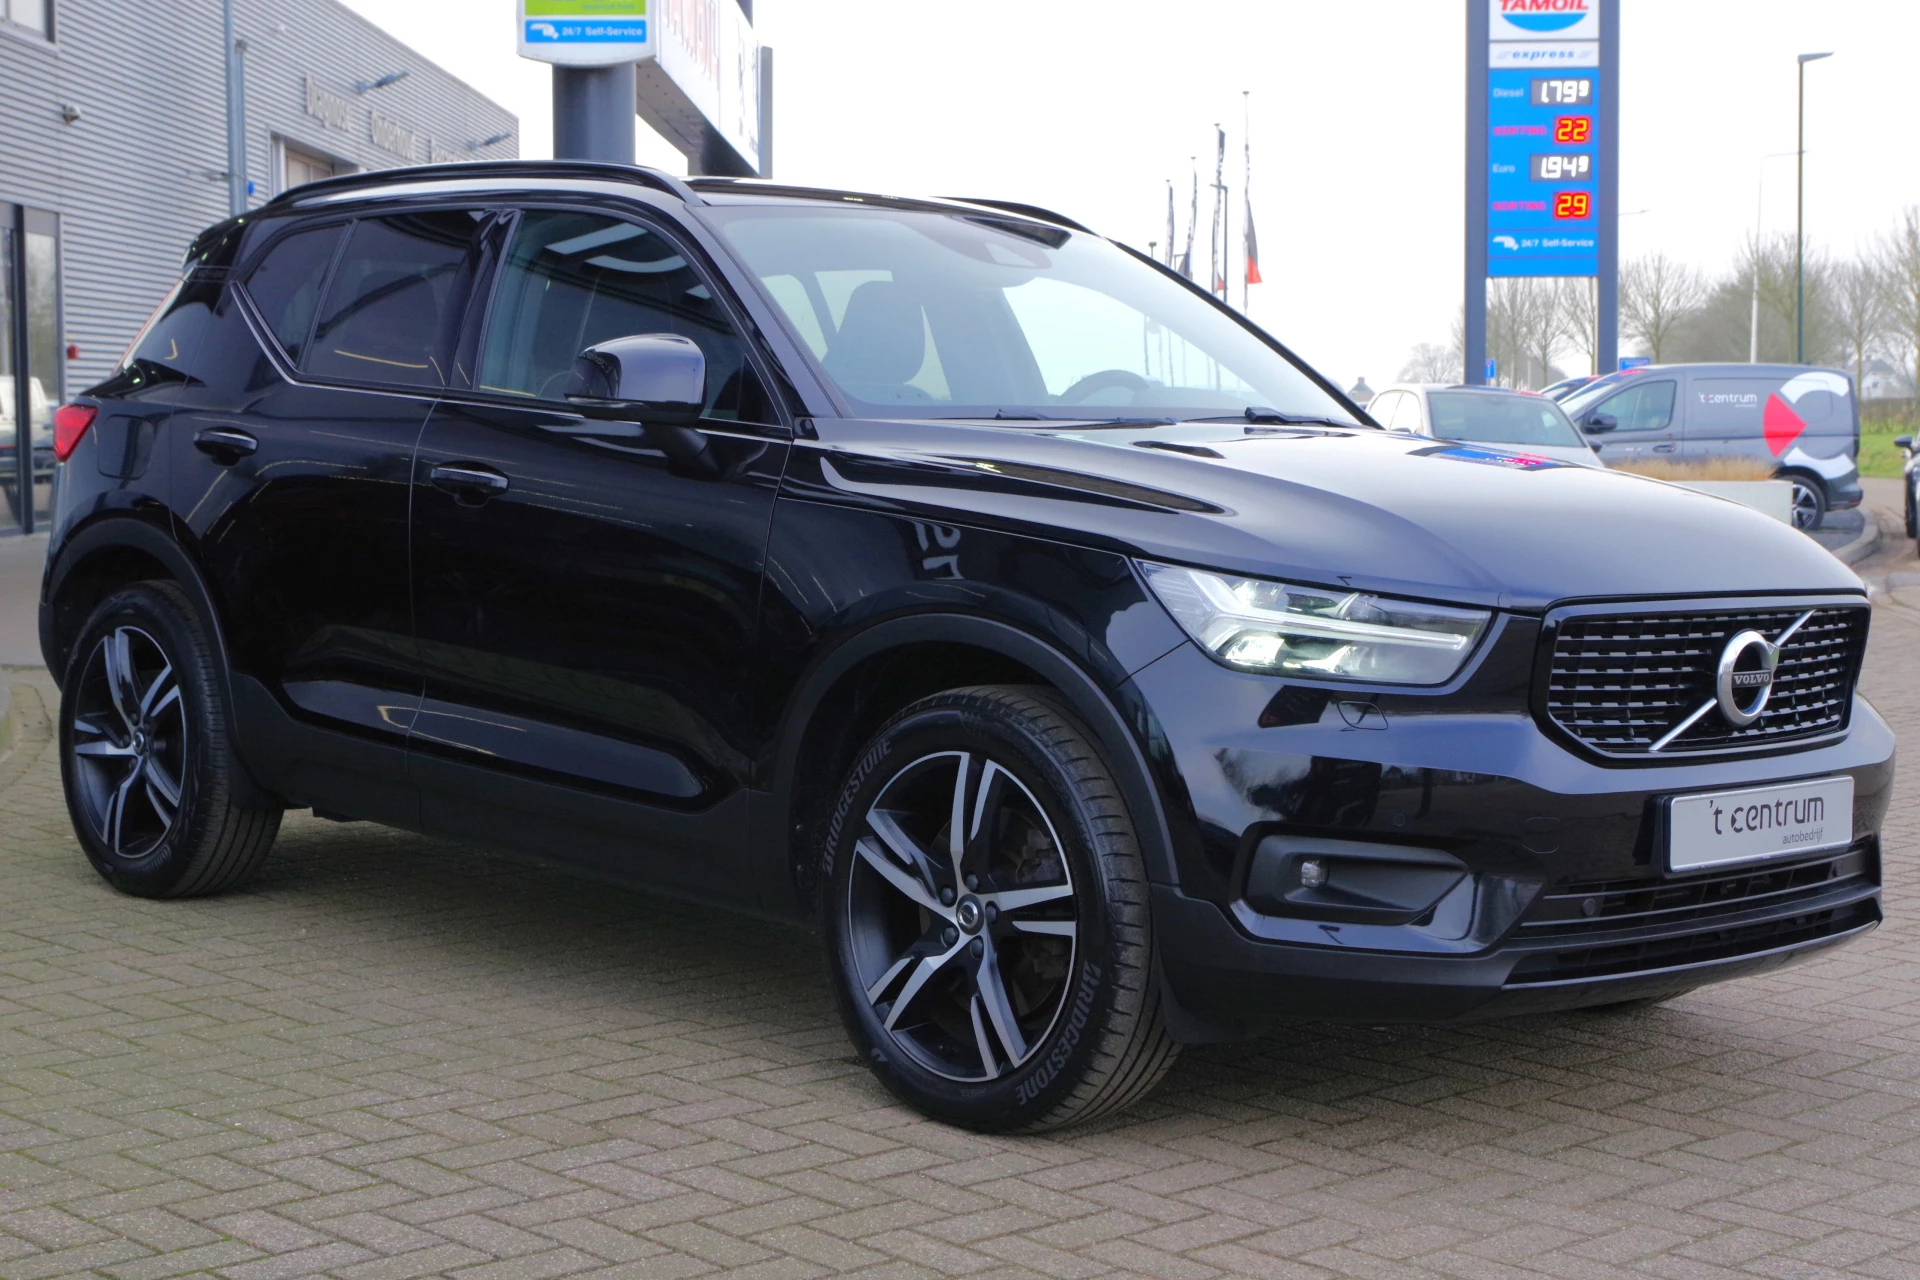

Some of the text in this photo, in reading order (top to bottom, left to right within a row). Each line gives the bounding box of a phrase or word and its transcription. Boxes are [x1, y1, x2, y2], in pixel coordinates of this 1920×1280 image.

[1499, 0, 1589, 11] TAMOIL
[562, 26, 643, 37] 24/7 Self-Service
[1512, 51, 1575, 61] express
[1492, 87, 1524, 98] Diesel
[1557, 119, 1589, 142] 22
[1492, 163, 1516, 174] Euro
[1557, 194, 1588, 217] 29
[1521, 237, 1594, 248] 24/7 Self-Service
[1707, 393, 1758, 404] centrum
[1733, 673, 1770, 686] VOLVO
[822, 738, 893, 877] BRIDGESTONE
[1709, 796, 1825, 835] 't centrum
[1782, 827, 1824, 845] autobedrijf
[1015, 959, 1102, 1106] BRIDGESTONE
